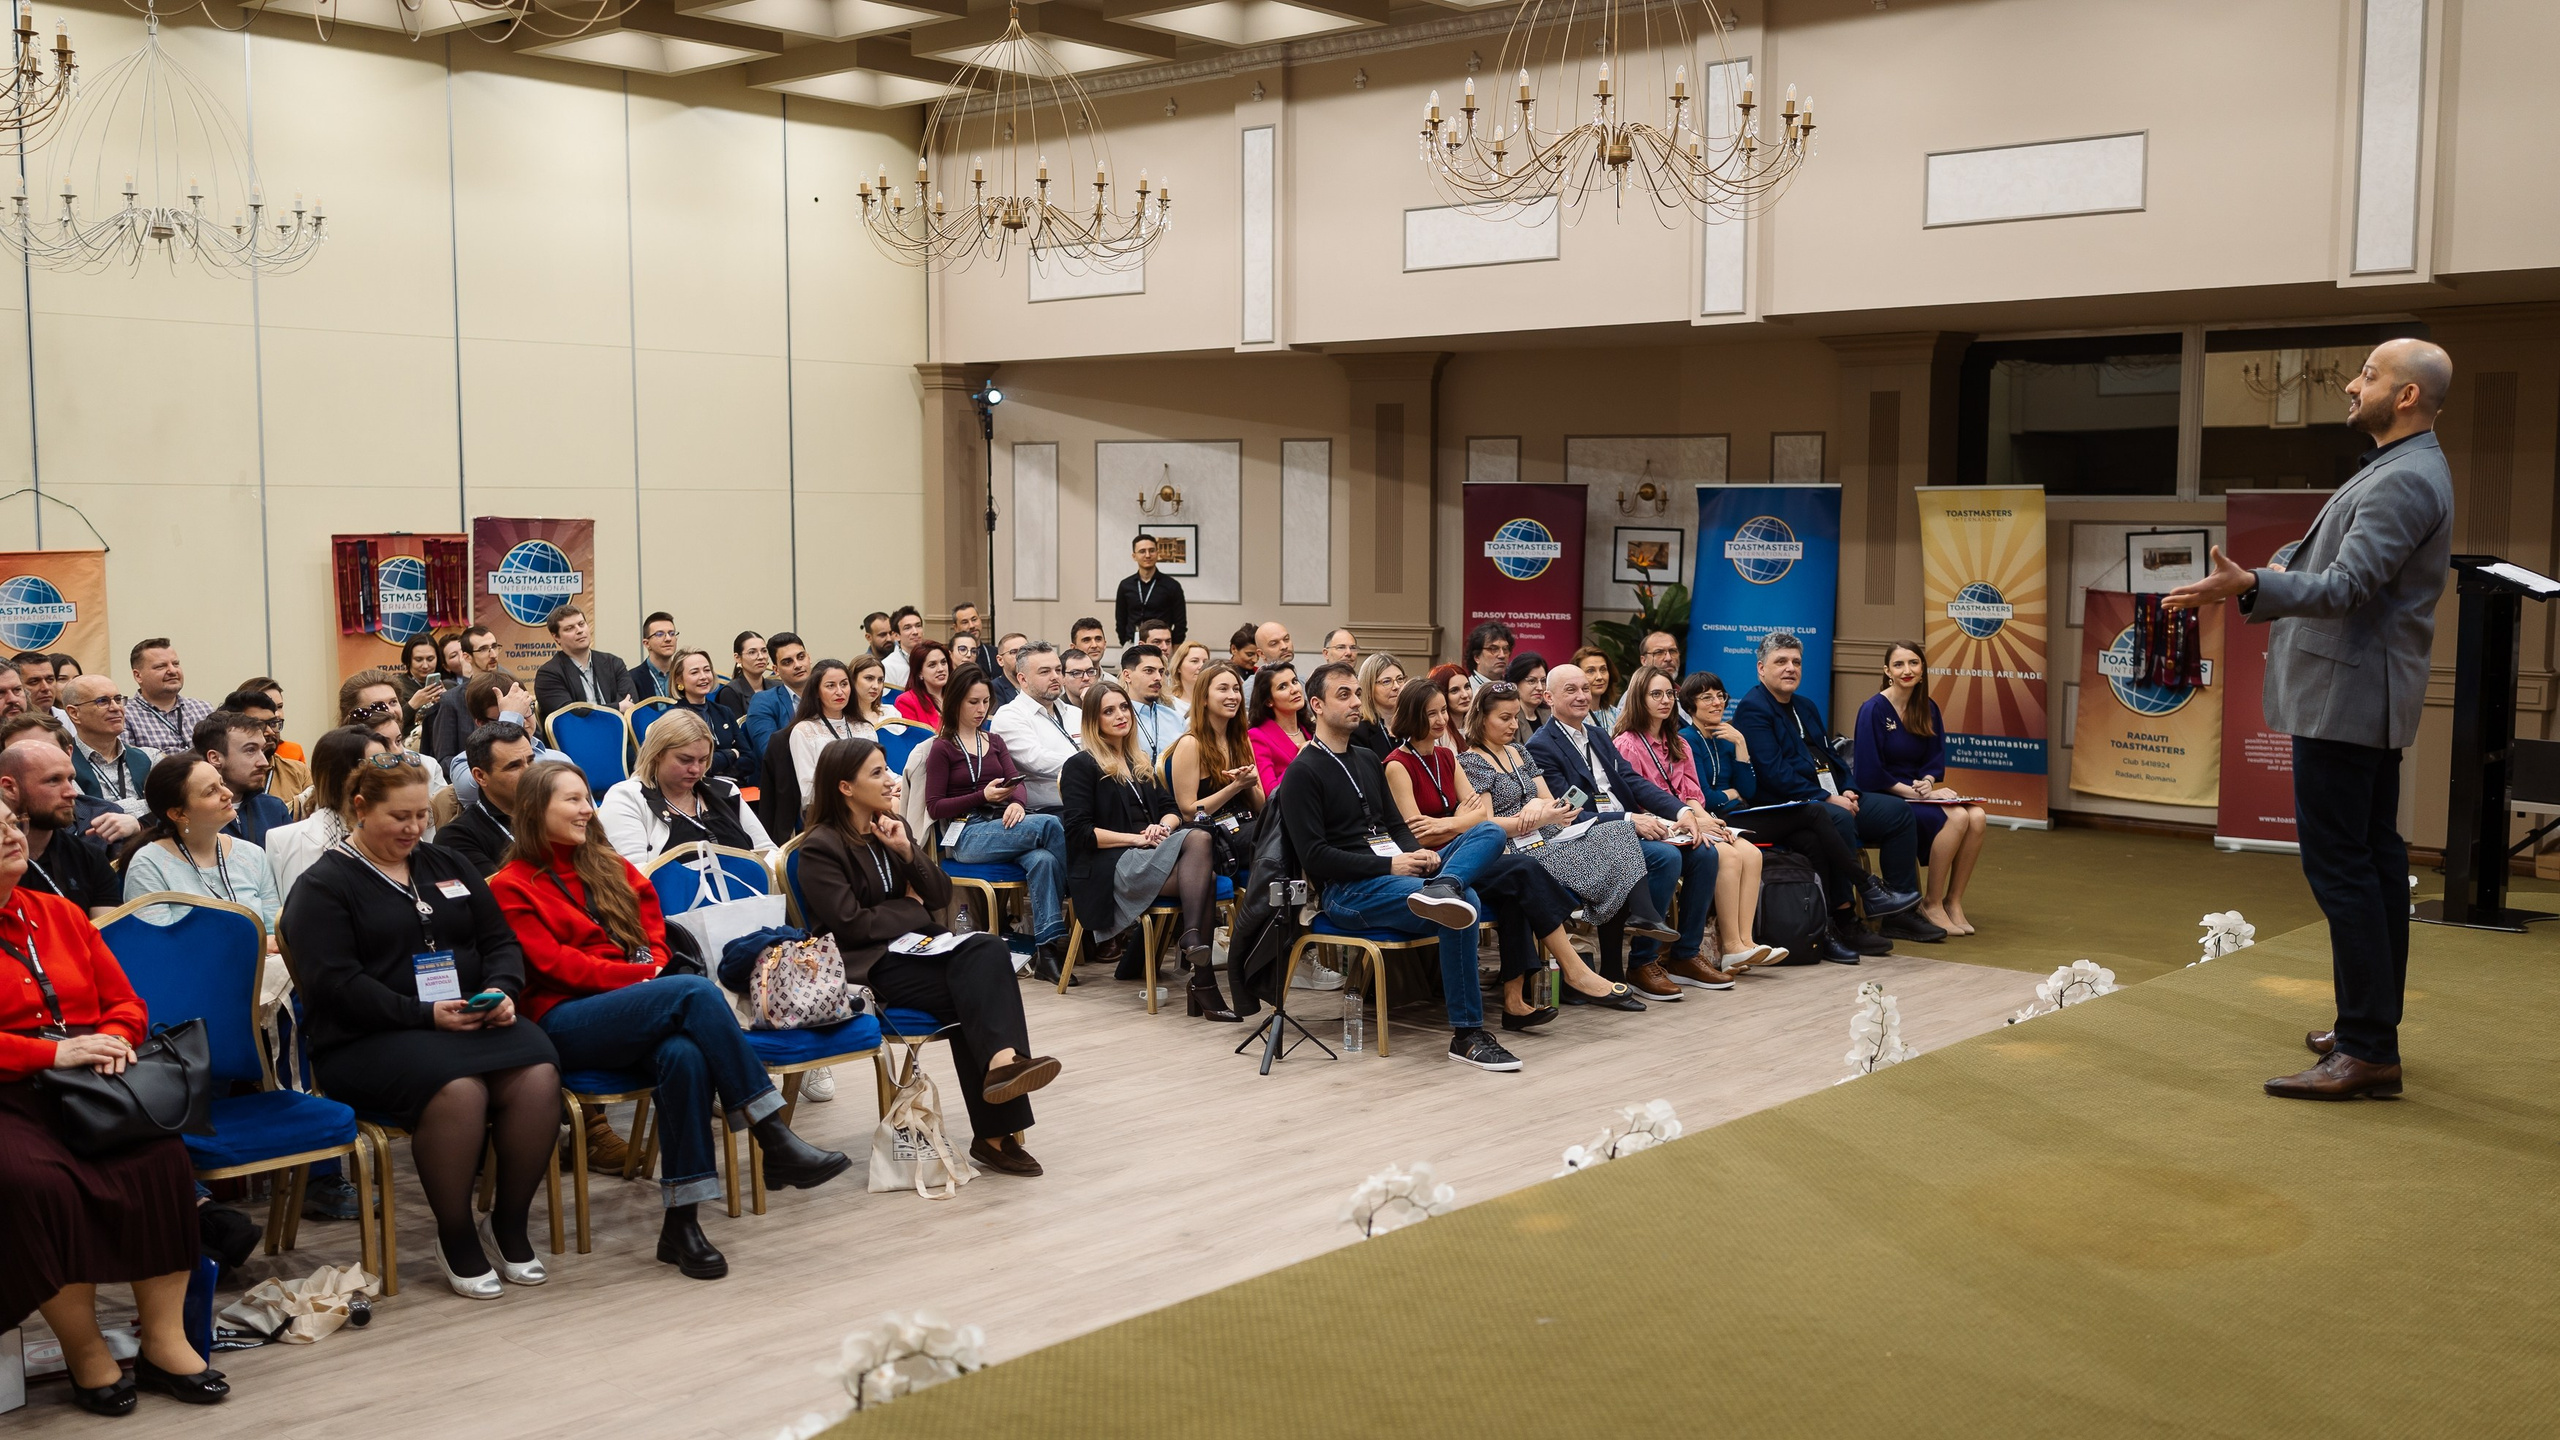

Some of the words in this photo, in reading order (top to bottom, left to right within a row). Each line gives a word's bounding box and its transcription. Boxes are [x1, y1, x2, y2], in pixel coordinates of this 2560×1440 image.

[1946, 509, 2013, 517] TOASTMASTERS
[1487, 543, 1559, 551] TOASTMASTERS
[1728, 543, 1800, 552] TOASTMASTERS
[491, 574, 580, 586] TOASTMASTERS
[381, 592, 427, 603] STMAST
[1950, 604, 2011, 613] TOASTMASTERS
[0, 614, 63, 622] TERNATIONAL
[1472, 611, 1506, 619] BRASOV
[1508, 612, 1572, 620] TOASTMASTERS
[1739, 624, 1796, 633] TOASTMASTERS
[1797, 626, 1817, 634] CLUB
[1723, 646, 1753, 655] Republic
[377, 664, 408, 672] TRANS
[1927, 667, 1952, 676] HERE
[1954, 668, 1994, 678] LEADERS
[1996, 671, 2014, 679] ARE
[2017, 671, 2043, 680] MADE
[2127, 731, 2169, 743] RADAUTI
[1969, 737, 2040, 750] Toastmasters
[2110, 739, 2185, 756] TOASTMASTERS
[1956, 748, 1972, 756] Club
[1974, 750, 2008, 759] 05418924
[1983, 757, 2014, 767] România
[2123, 757, 2139, 766] Club
[2141, 759, 2170, 769] 5418924
[2115, 769, 2144, 781] Radauti,
[2145, 773, 2177, 783] Romania
